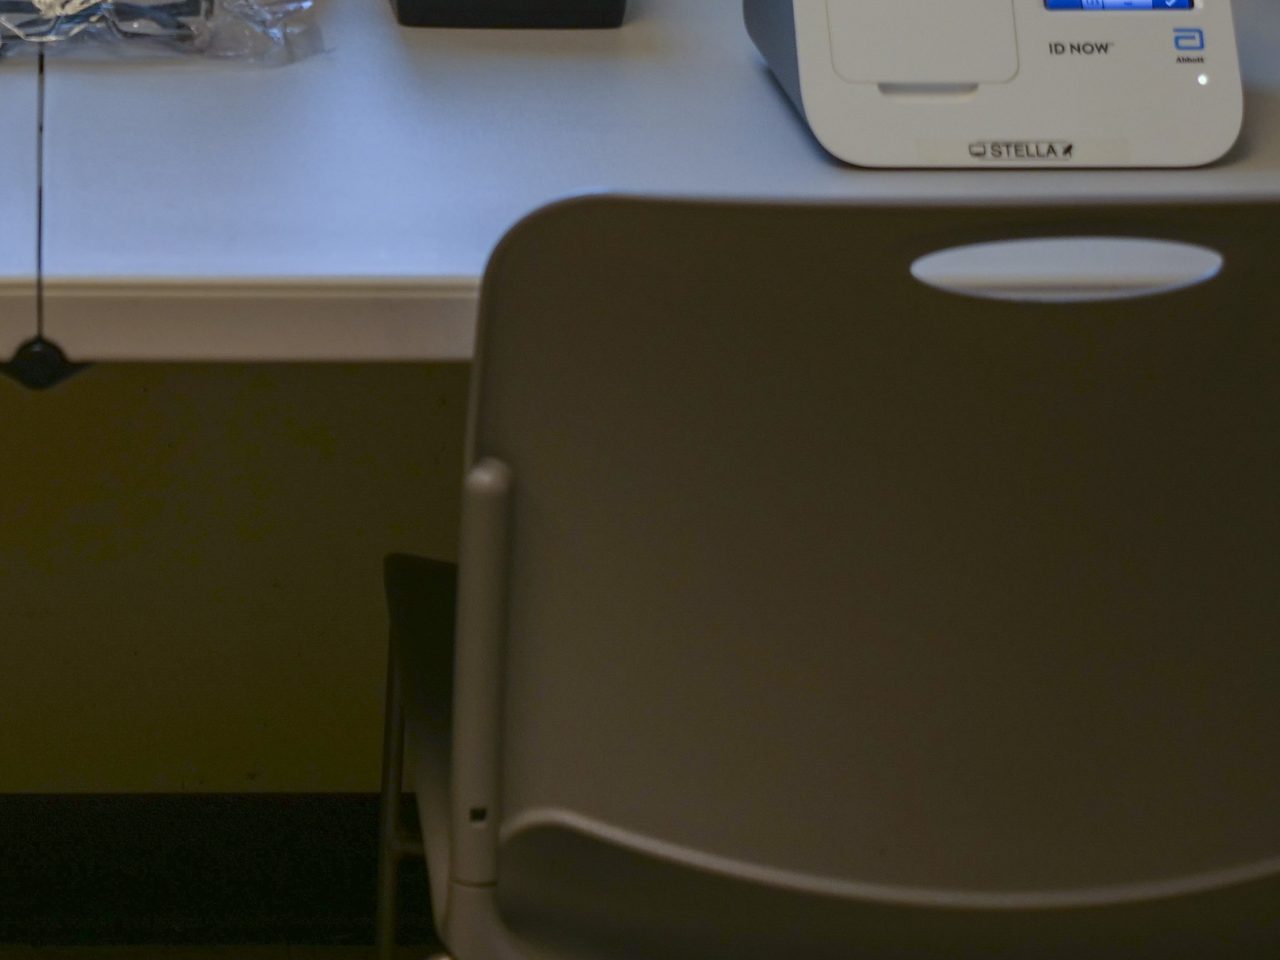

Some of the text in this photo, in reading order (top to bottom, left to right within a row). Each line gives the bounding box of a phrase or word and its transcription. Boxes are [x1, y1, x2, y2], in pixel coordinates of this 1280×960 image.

[1048, 42, 1110, 55] ID NOW
[990, 142, 1058, 158] STELLA
